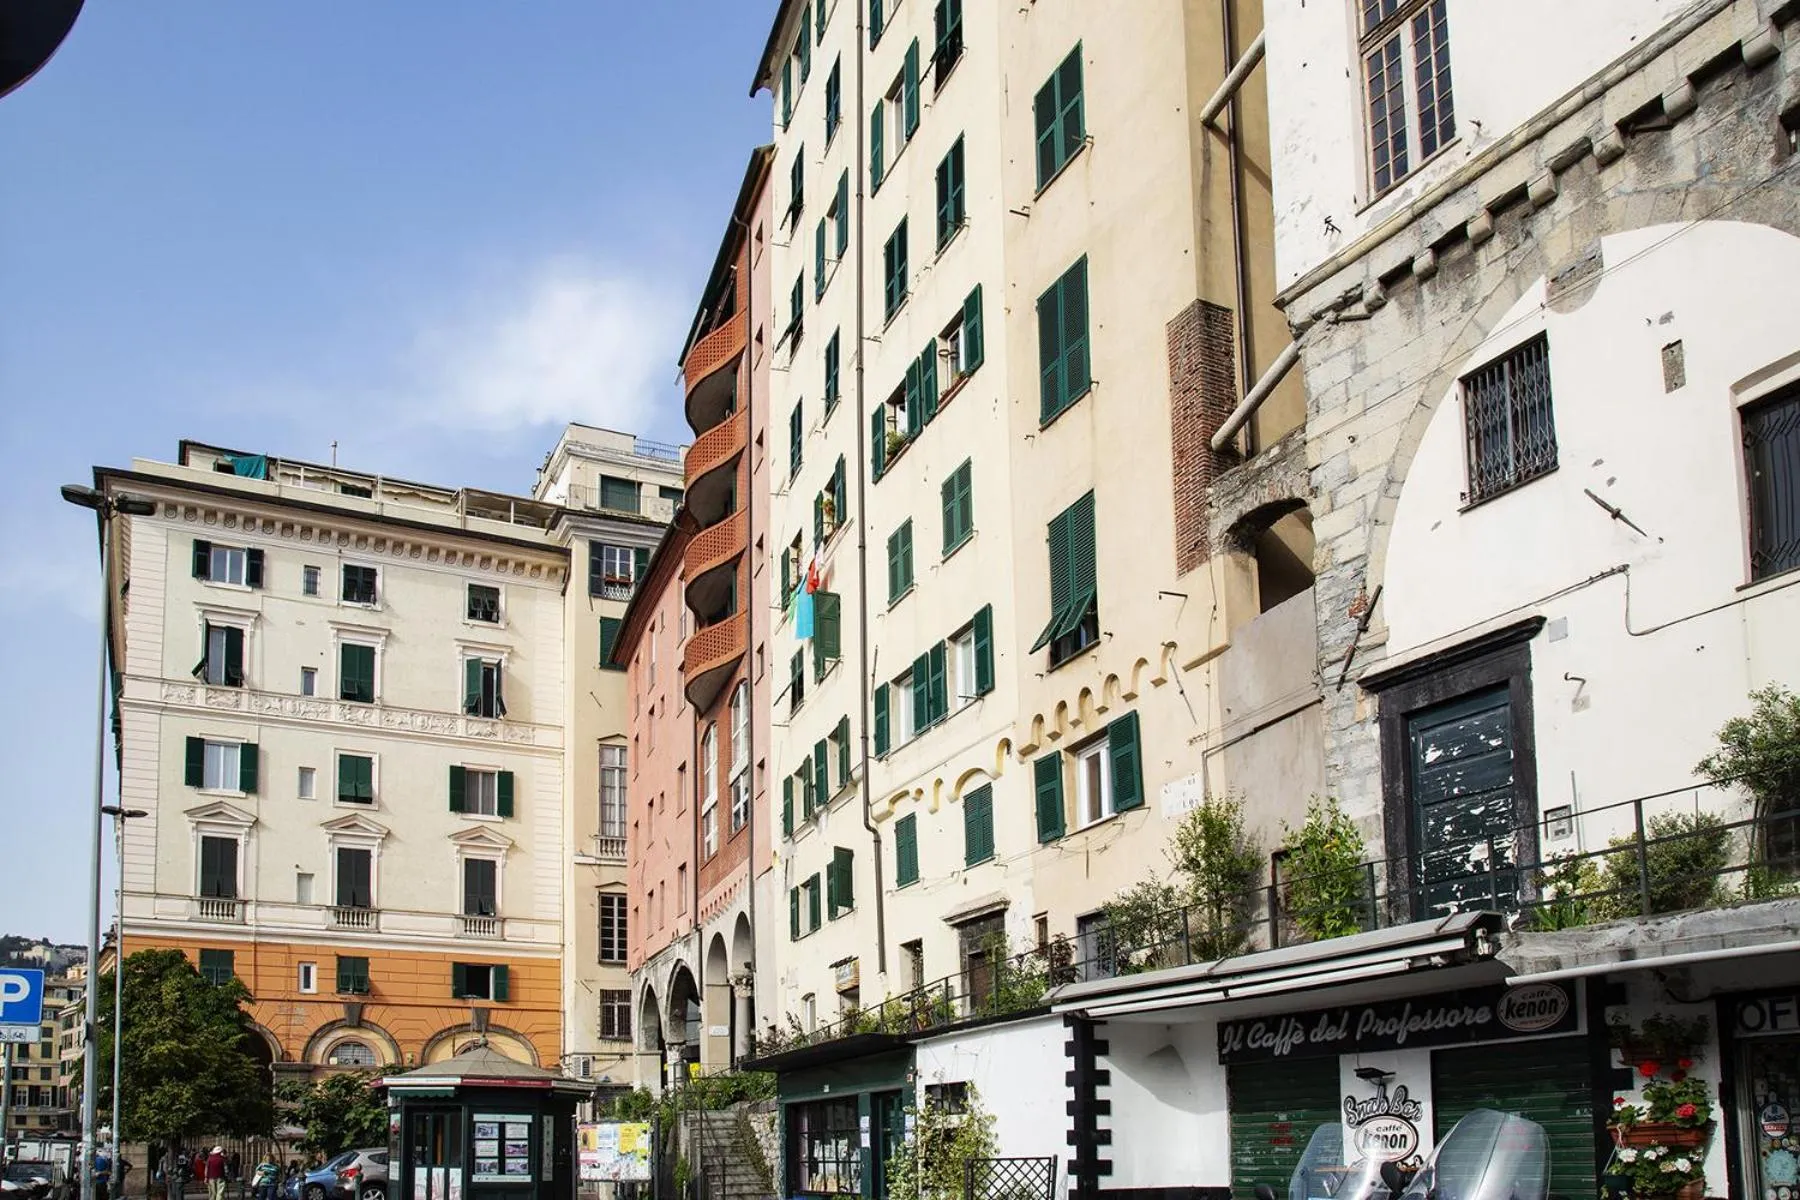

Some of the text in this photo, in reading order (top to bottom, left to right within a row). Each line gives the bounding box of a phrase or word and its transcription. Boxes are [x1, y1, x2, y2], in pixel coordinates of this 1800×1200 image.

[0, 974, 31, 1018] P
[1505, 997, 1559, 1020] kenon
[1739, 997, 1800, 1031] OF
[1221, 1001, 1493, 1057] Il Caffè del Professore
[1389, 1085, 1423, 1122] Bar
